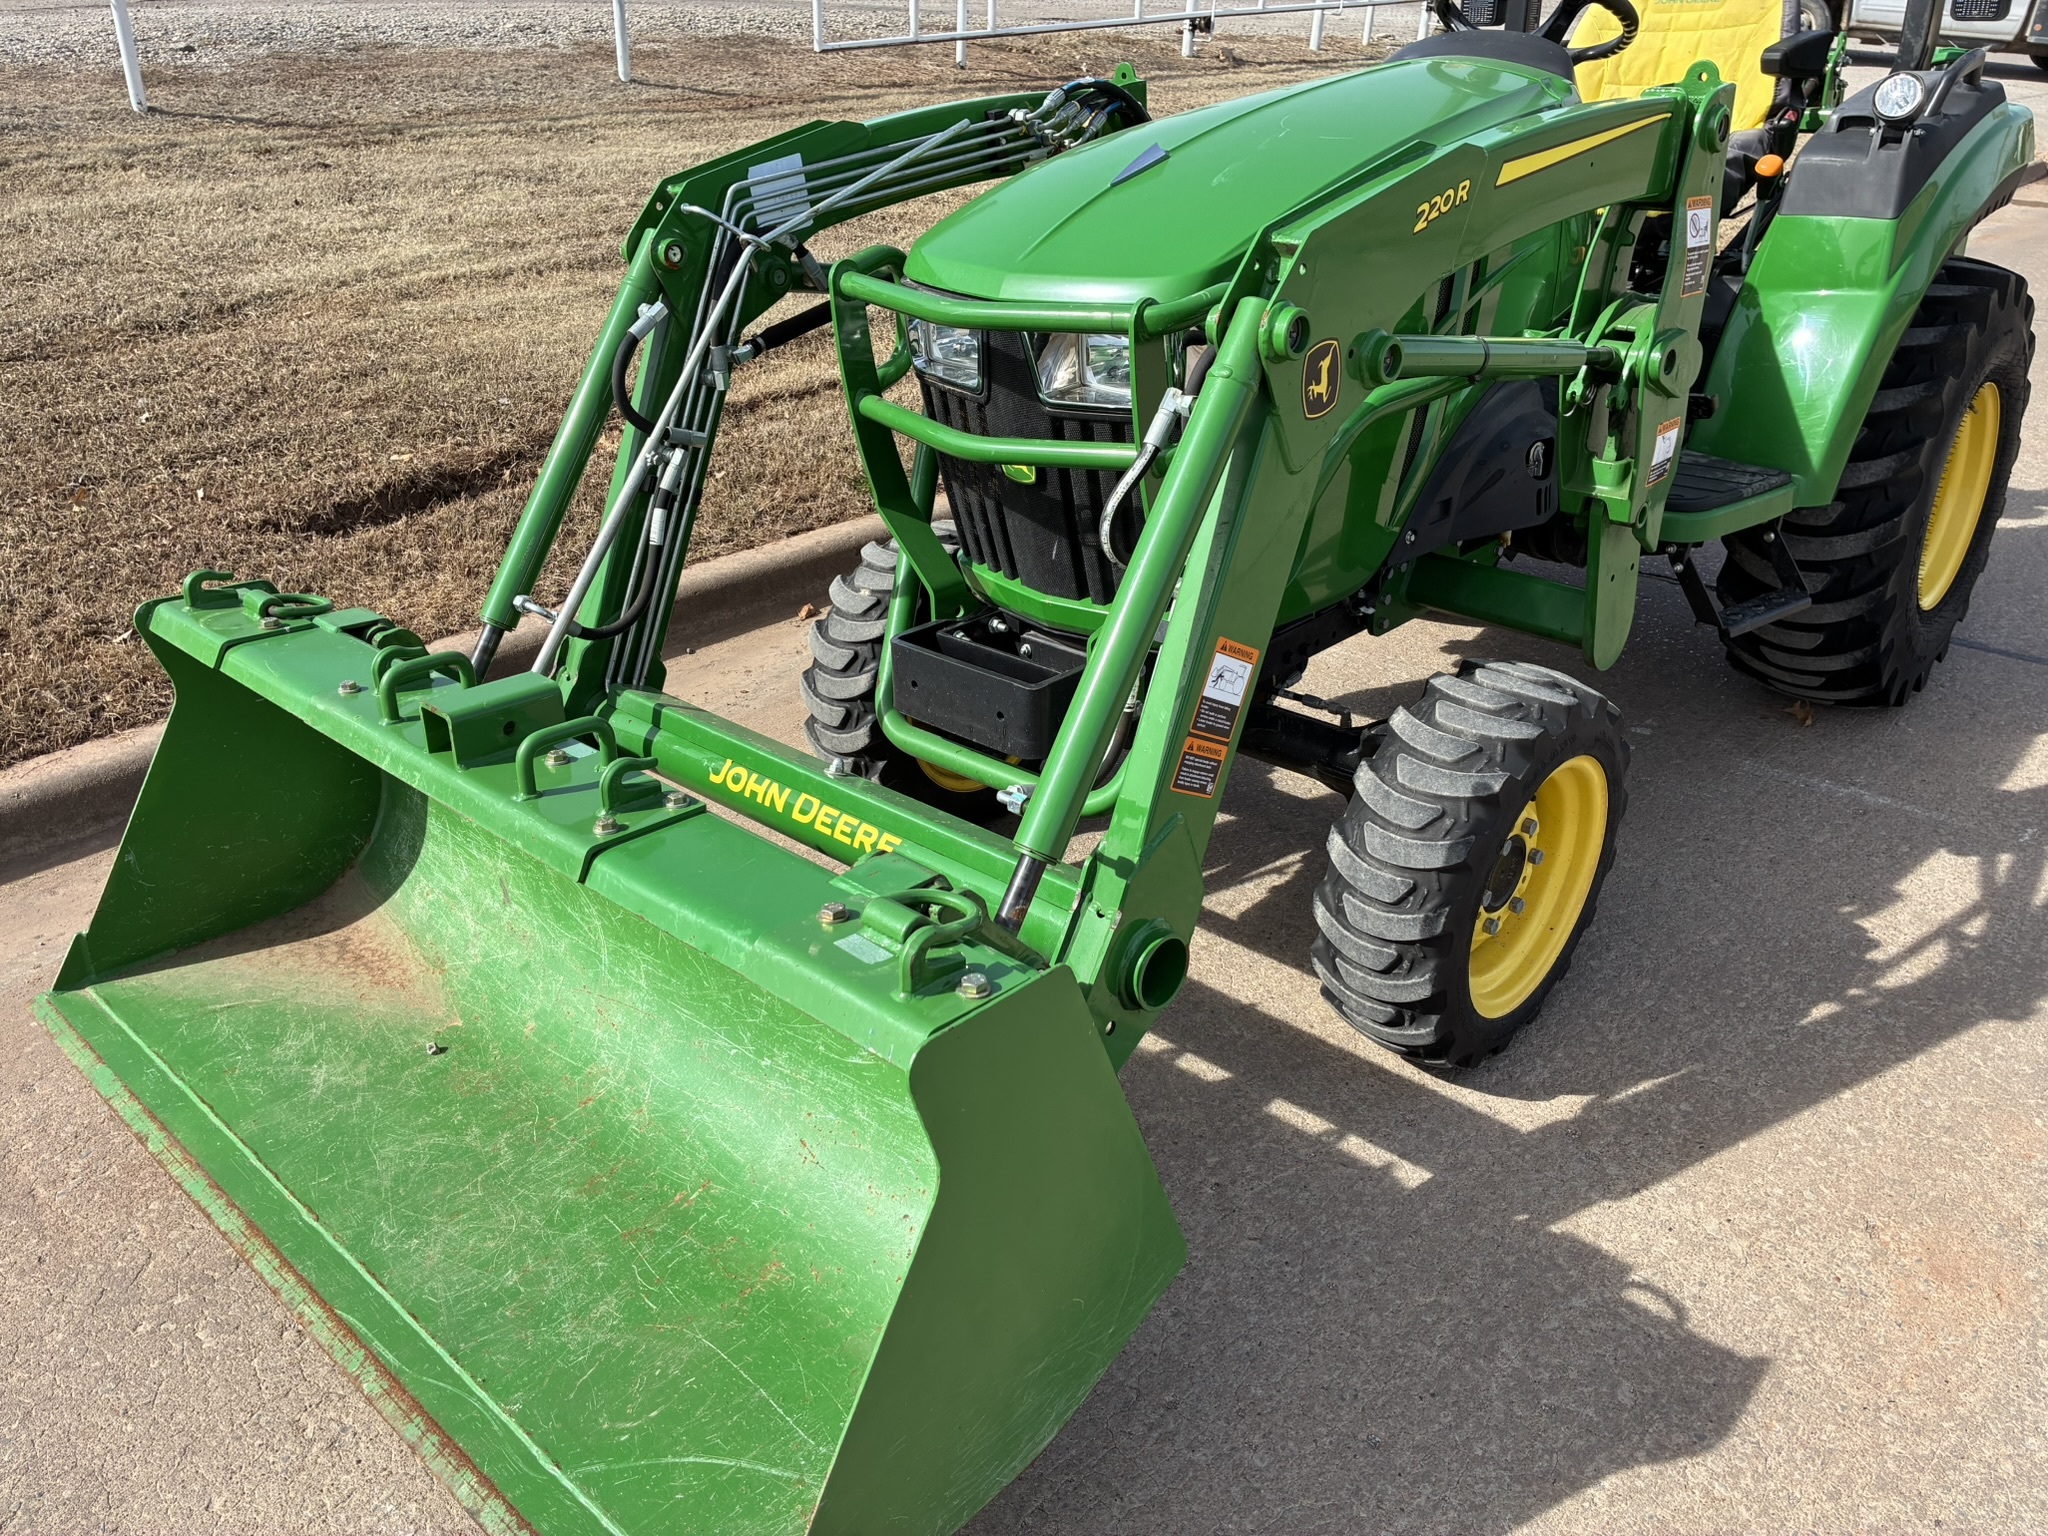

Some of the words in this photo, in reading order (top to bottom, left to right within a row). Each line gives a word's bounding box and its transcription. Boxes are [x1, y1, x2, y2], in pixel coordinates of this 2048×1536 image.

[1227, 643, 1253, 661] WARNING
[1196, 743, 1222, 757] WARNING
[709, 758, 791, 813] JOHN
